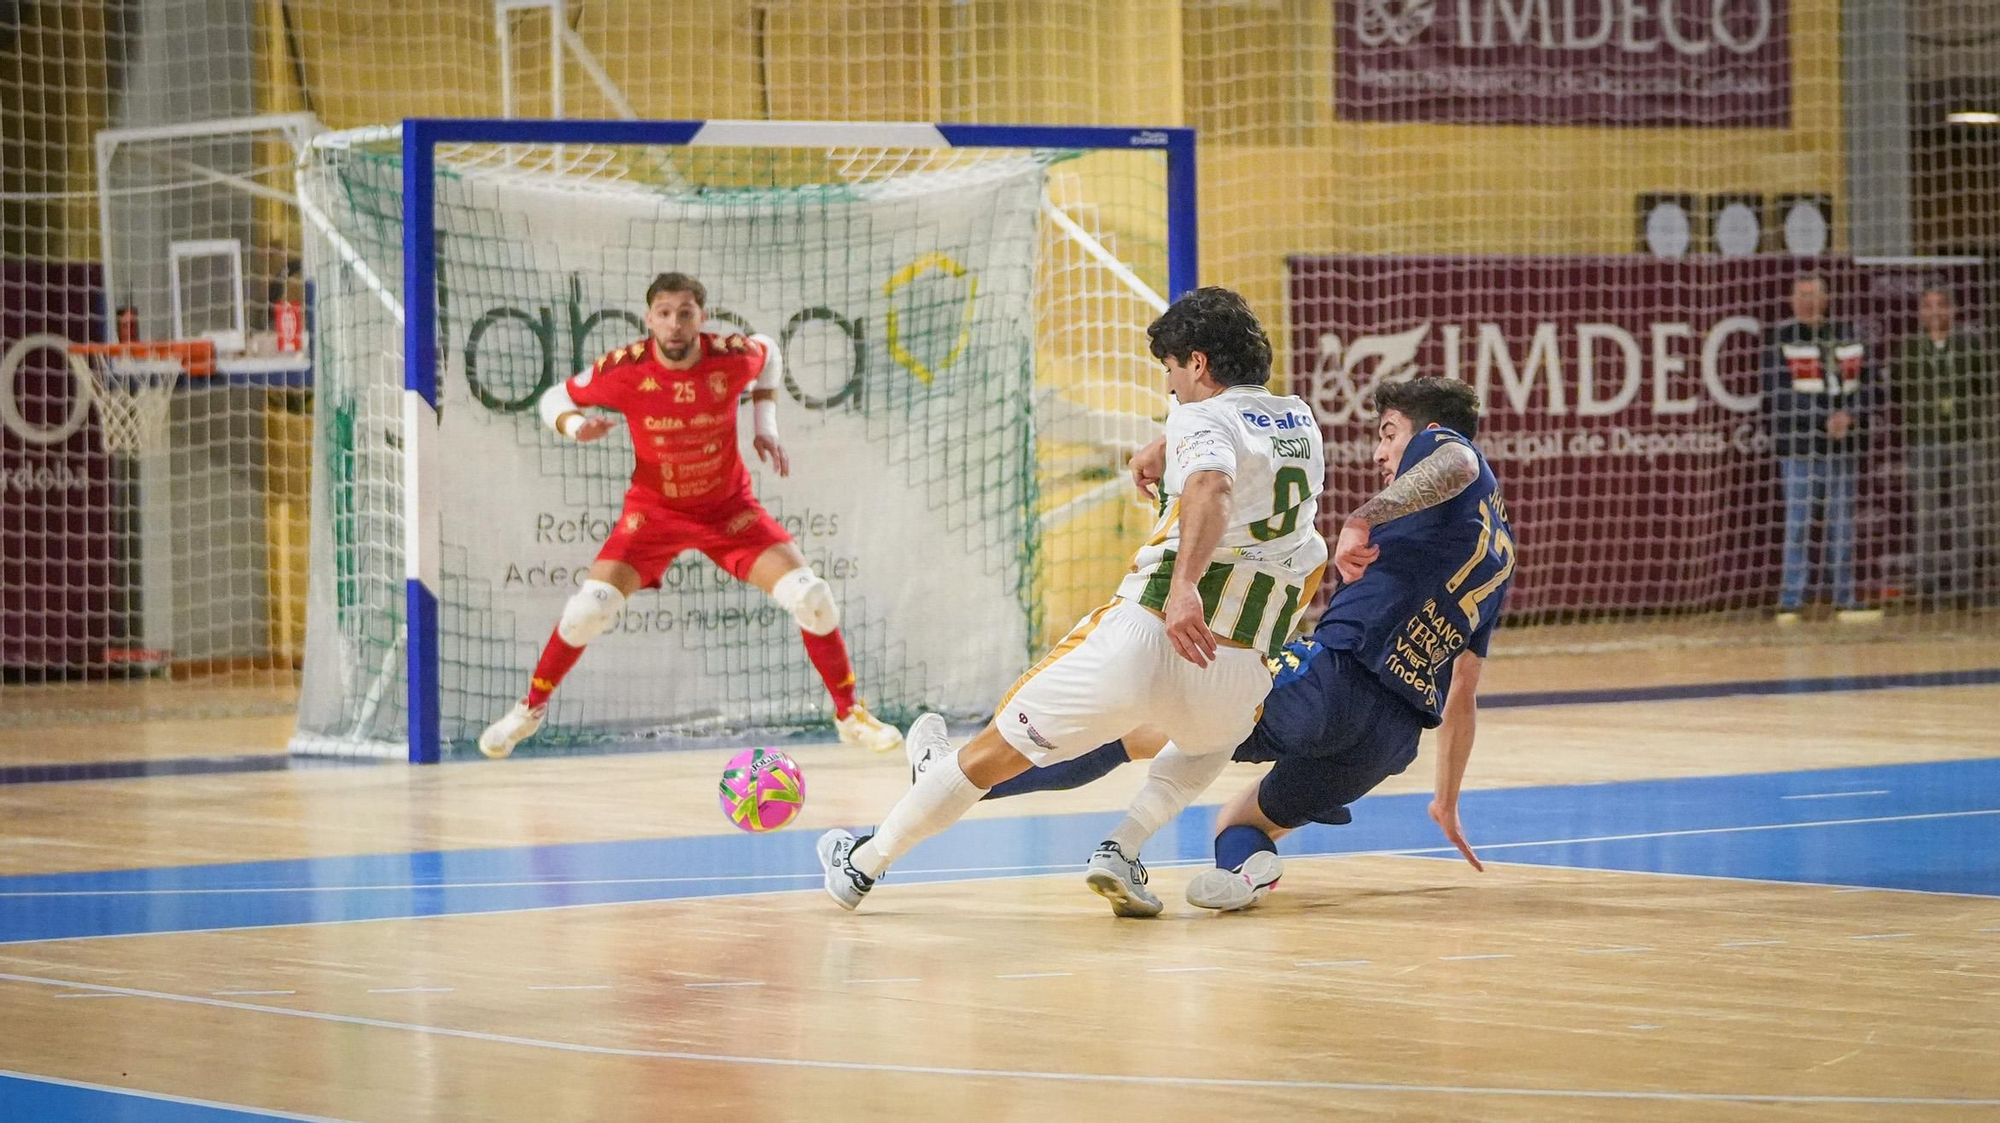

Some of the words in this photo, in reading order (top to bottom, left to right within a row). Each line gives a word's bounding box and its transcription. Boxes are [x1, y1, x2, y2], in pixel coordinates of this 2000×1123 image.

[1457, 0, 1771, 53] IMDECO
[1442, 314, 1766, 417] IMDEC
[673, 381, 697, 403] 25
[1477, 430, 1563, 466] nicipal
[1568, 427, 1606, 457] de
[1611, 427, 1727, 462] Deportes
[0, 460, 91, 493] rdoba
[1445, 499, 1516, 632] 12
